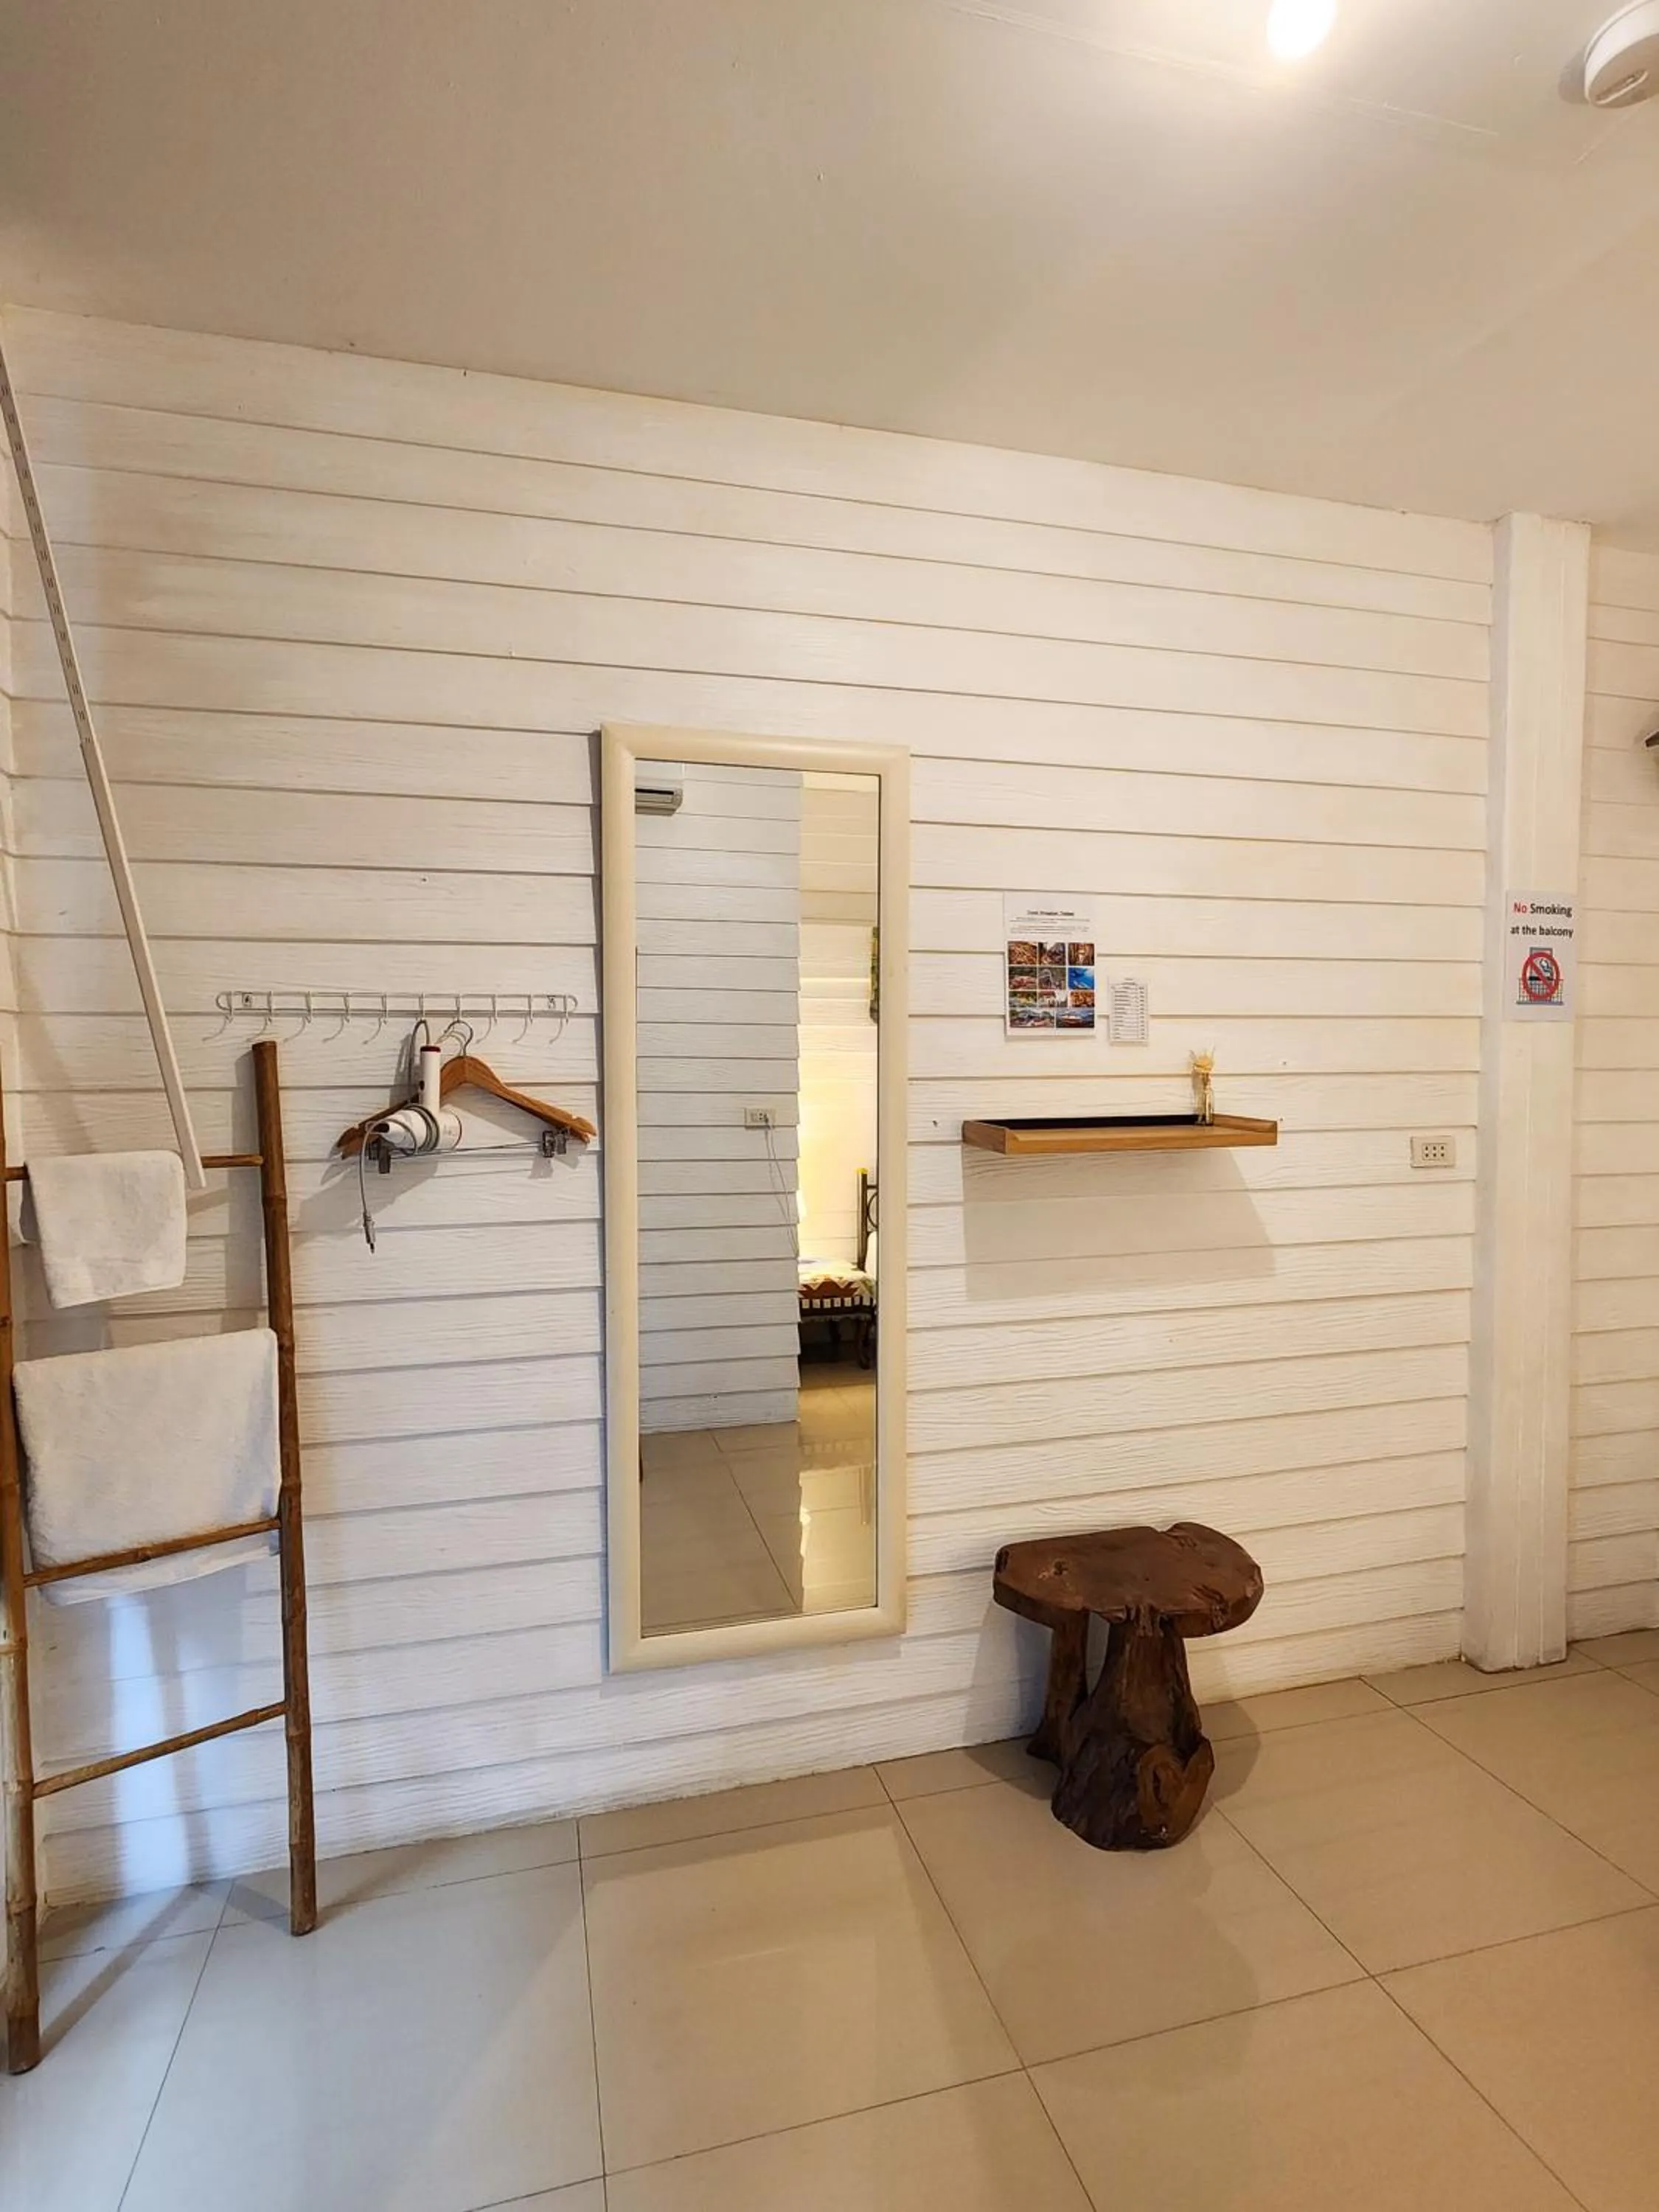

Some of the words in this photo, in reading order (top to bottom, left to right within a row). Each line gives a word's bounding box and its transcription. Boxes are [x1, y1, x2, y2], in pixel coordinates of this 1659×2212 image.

[1514, 902, 1527, 913] No
[1530, 903, 1572, 917] Smoking
[1510, 925, 1520, 934] at
[1522, 924, 1537, 935] the
[1539, 925, 1573, 938] balcony
